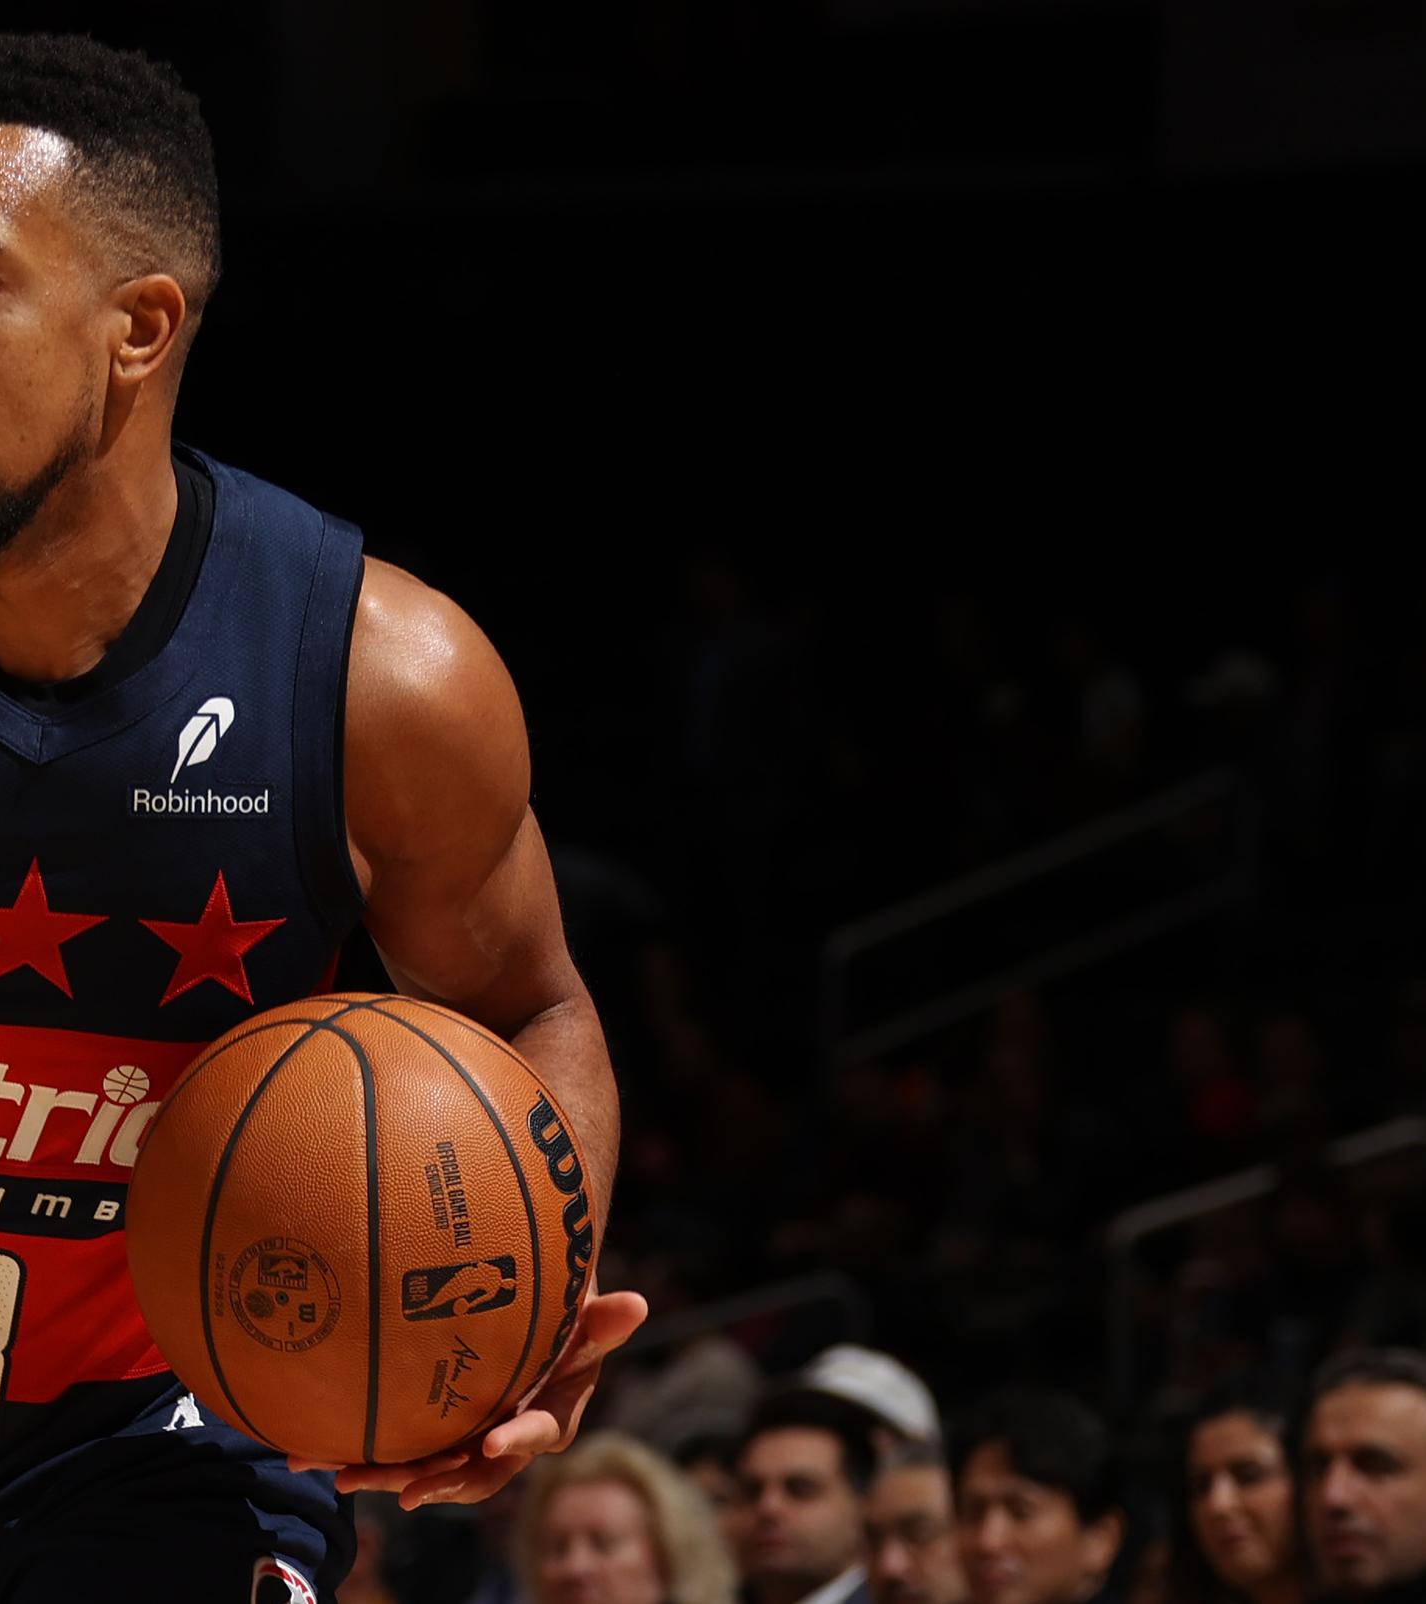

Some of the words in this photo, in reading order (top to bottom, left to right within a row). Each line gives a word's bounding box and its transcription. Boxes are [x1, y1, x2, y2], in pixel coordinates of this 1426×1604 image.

[133, 787, 269, 814] Robinhood
[436, 1141, 462, 1188] OFFICIAL
[448, 1189, 469, 1220] GAME
[453, 1221, 472, 1249] BALL
[408, 1275, 429, 1302] NBA
